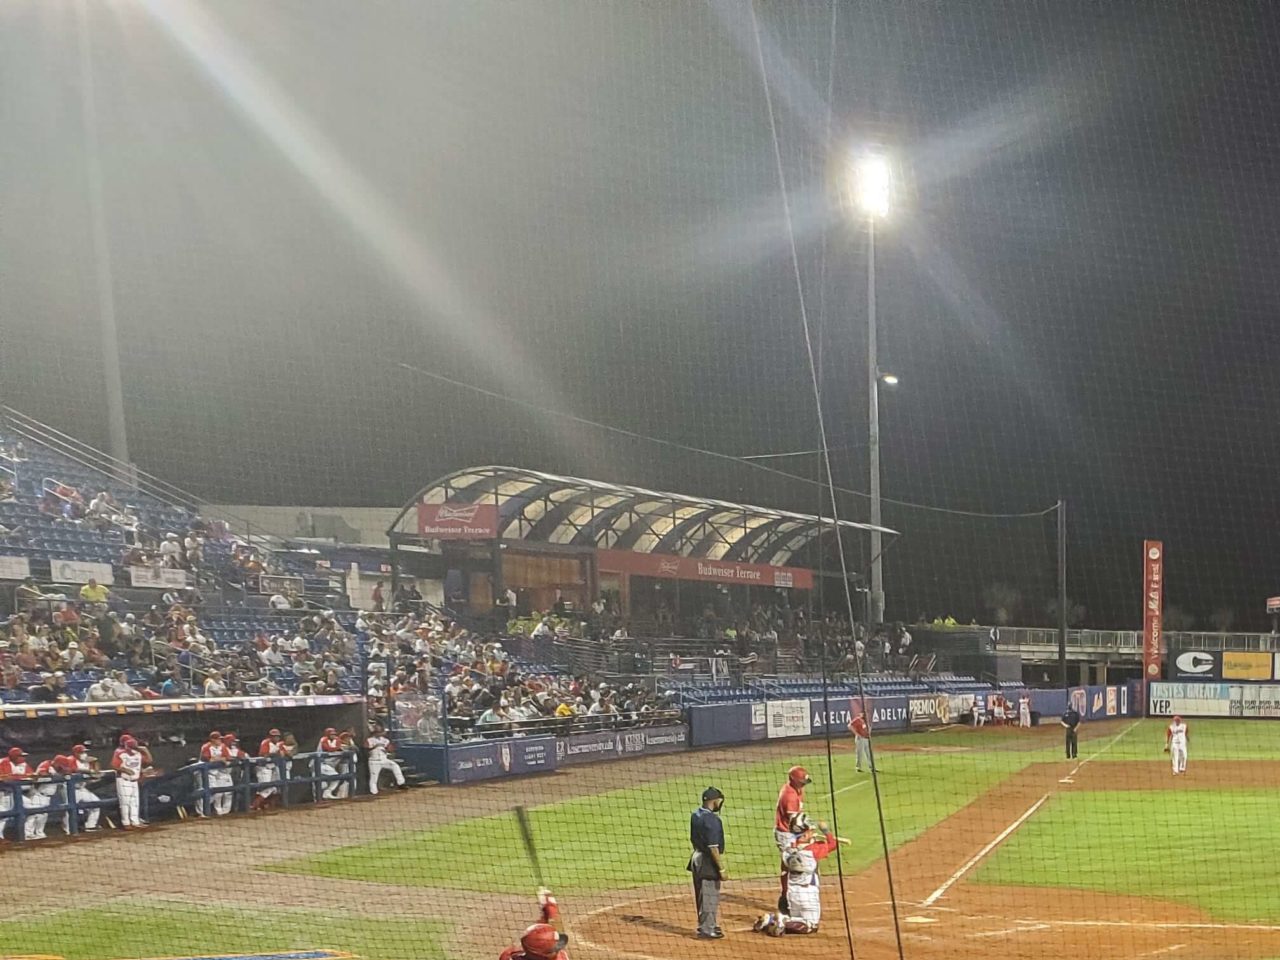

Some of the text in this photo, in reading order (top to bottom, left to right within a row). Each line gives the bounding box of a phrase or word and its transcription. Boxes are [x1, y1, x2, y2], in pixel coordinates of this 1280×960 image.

[1151, 685, 1184, 698] TASTES
[909, 699, 936, 715] PREMIO
[1152, 700, 1172, 713] YEP.
[880, 708, 907, 721] DELTA
